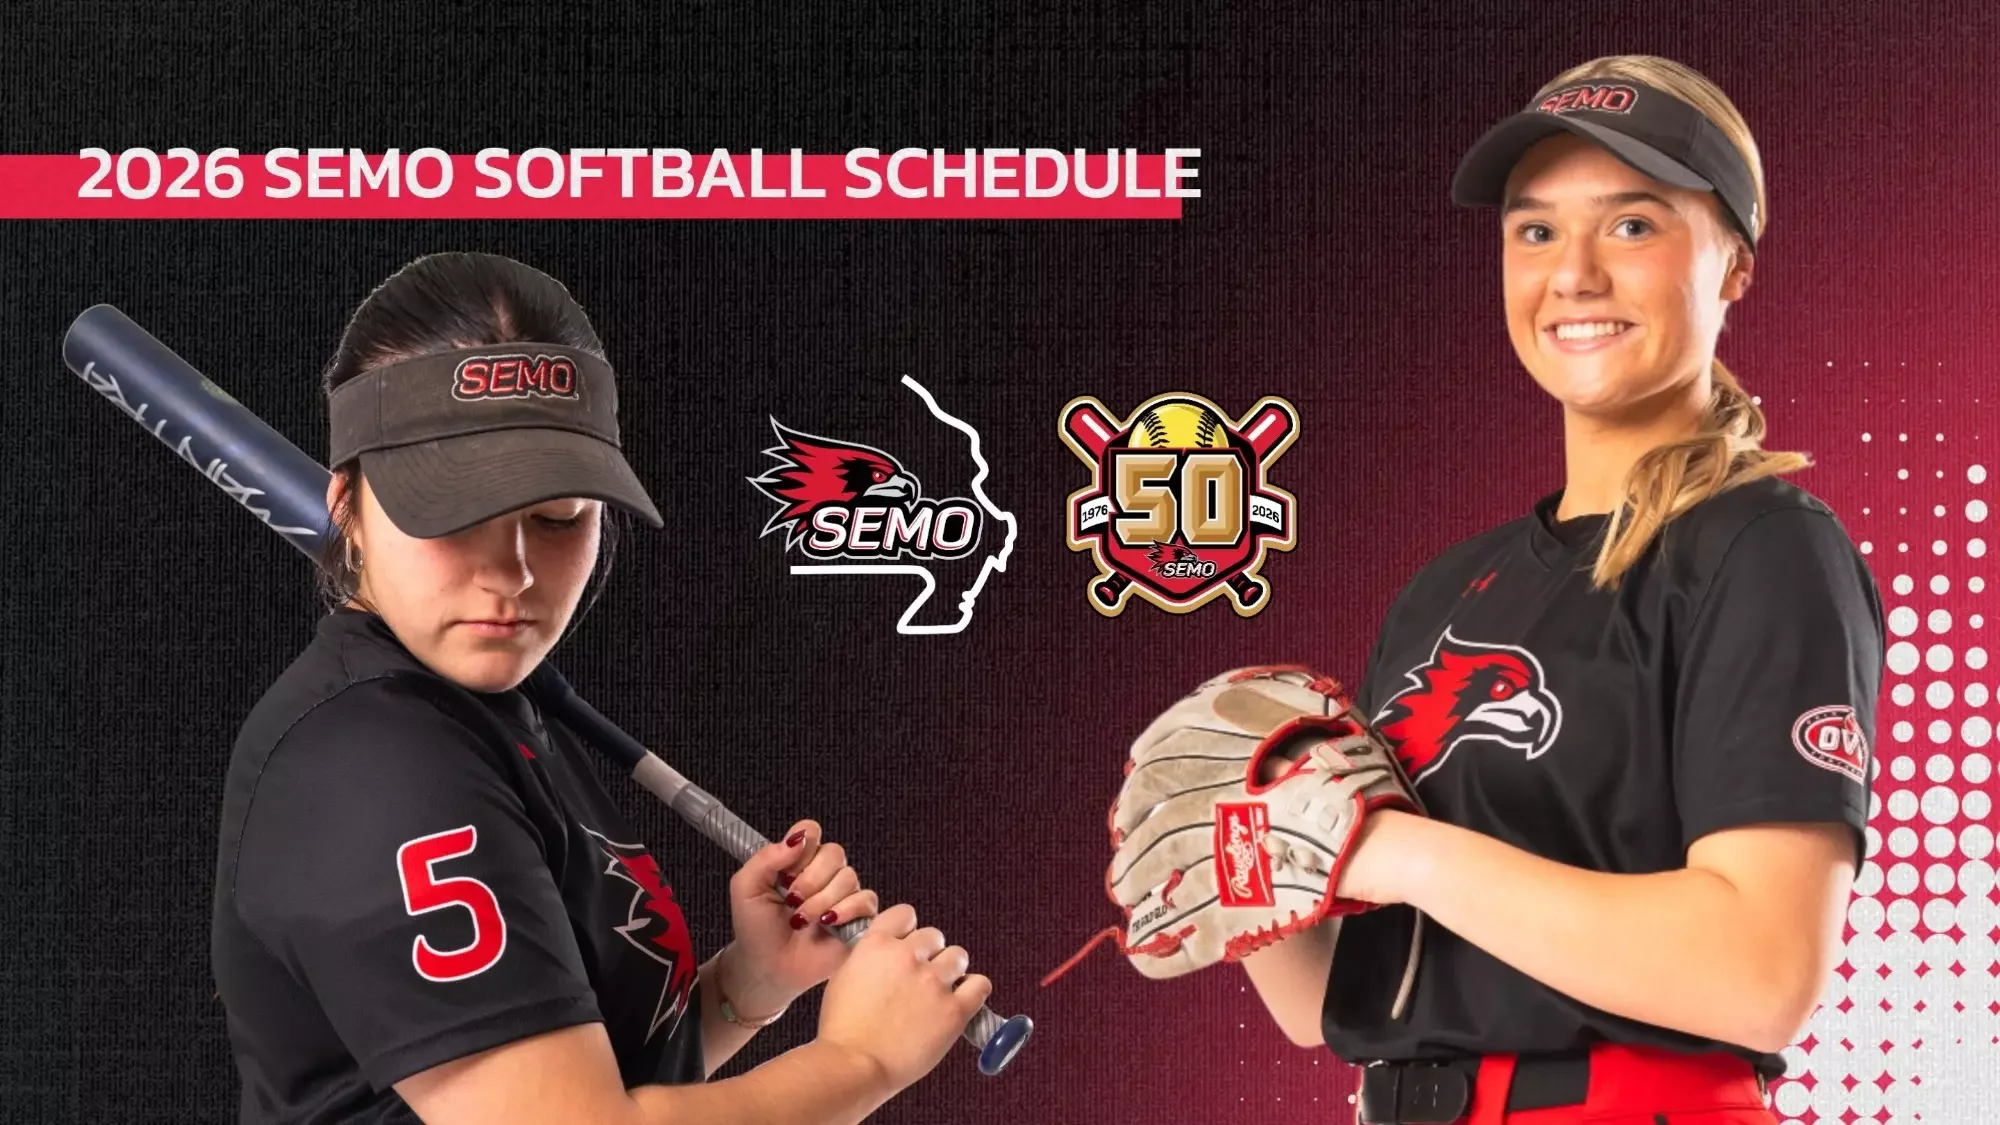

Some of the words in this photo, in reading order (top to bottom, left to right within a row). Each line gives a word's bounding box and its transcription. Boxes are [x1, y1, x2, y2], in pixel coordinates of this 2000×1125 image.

[1540, 86, 1634, 113] SEMO
[459, 359, 574, 395] SEMO
[1818, 725, 1862, 757] OV
[1225, 810, 1254, 899] Rawlings
[396, 824, 507, 983] 5
